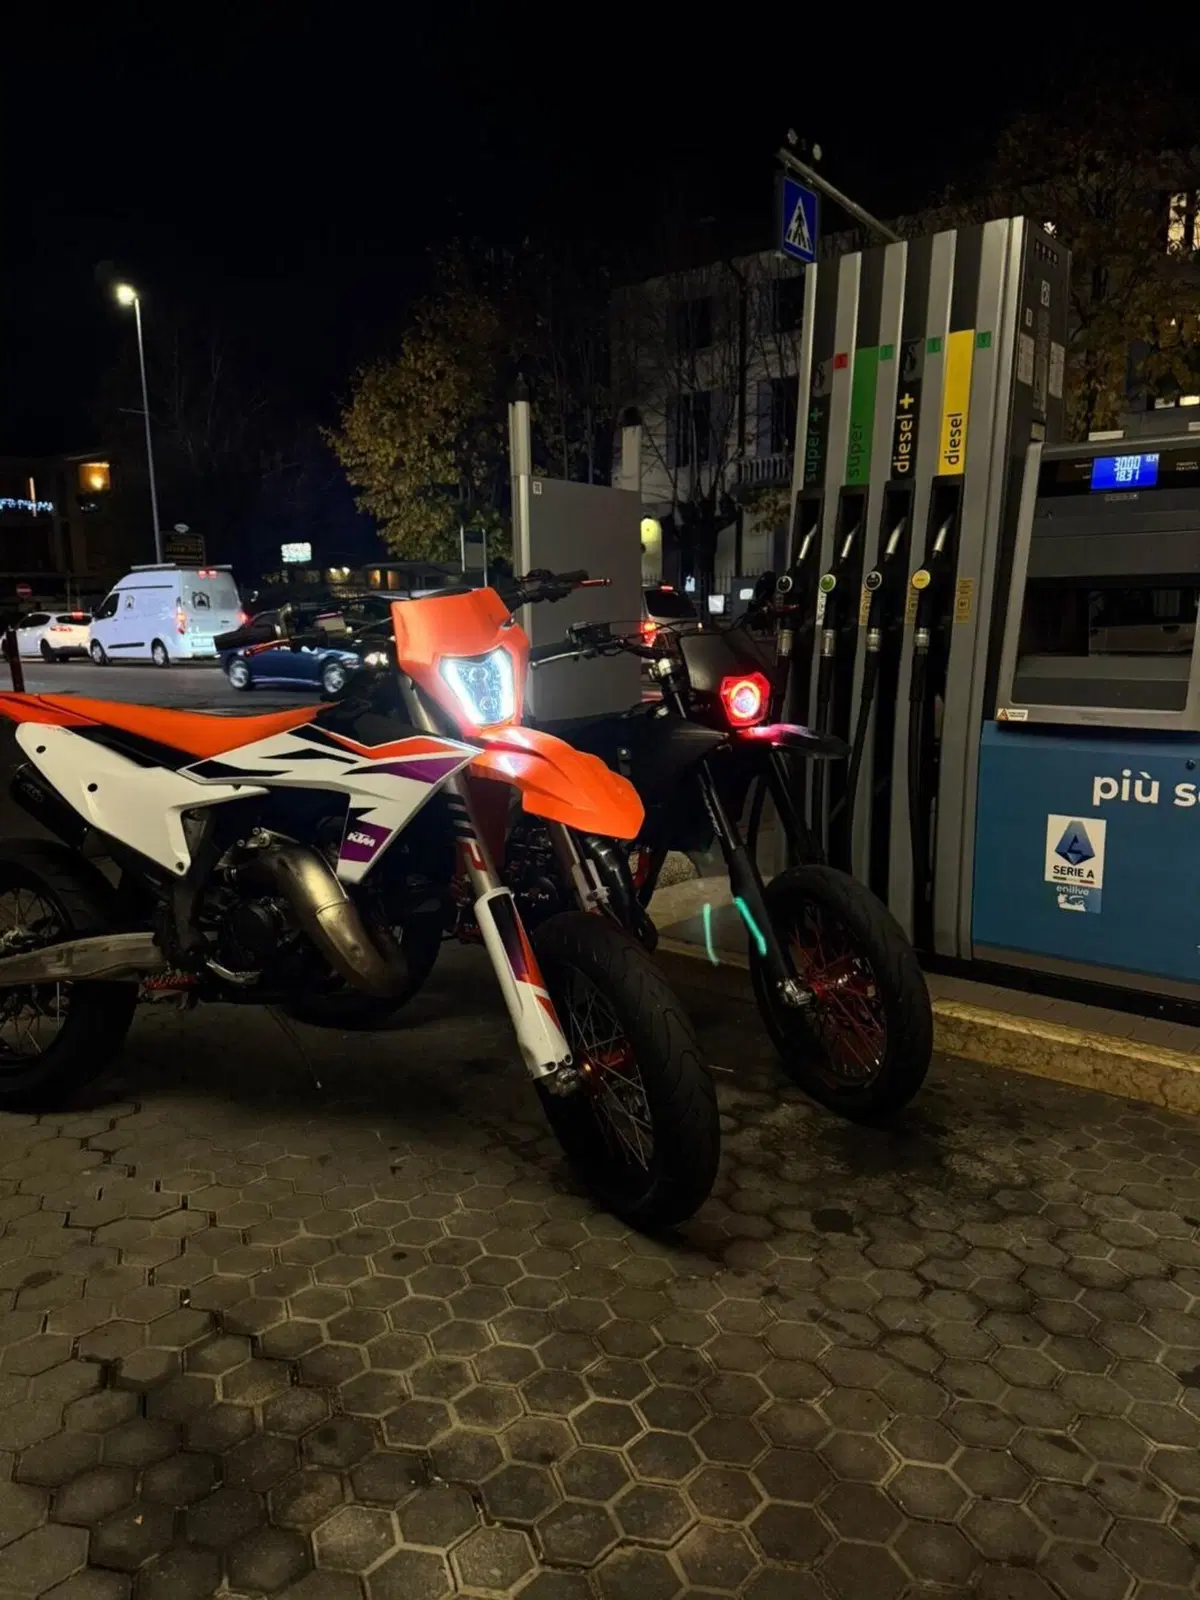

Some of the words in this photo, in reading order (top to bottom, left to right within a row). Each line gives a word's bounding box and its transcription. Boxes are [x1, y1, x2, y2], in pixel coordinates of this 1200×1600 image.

[805, 430, 821, 482] super
[848, 423, 864, 478] super
[892, 413, 914, 473] diesel
[944, 412, 963, 465] diesel
[1092, 768, 1160, 806] più
[1173, 782, 1200, 807] s
[346, 831, 376, 847] KTM
[1053, 865, 1084, 878] SERIE
[1086, 869, 1095, 879] A
